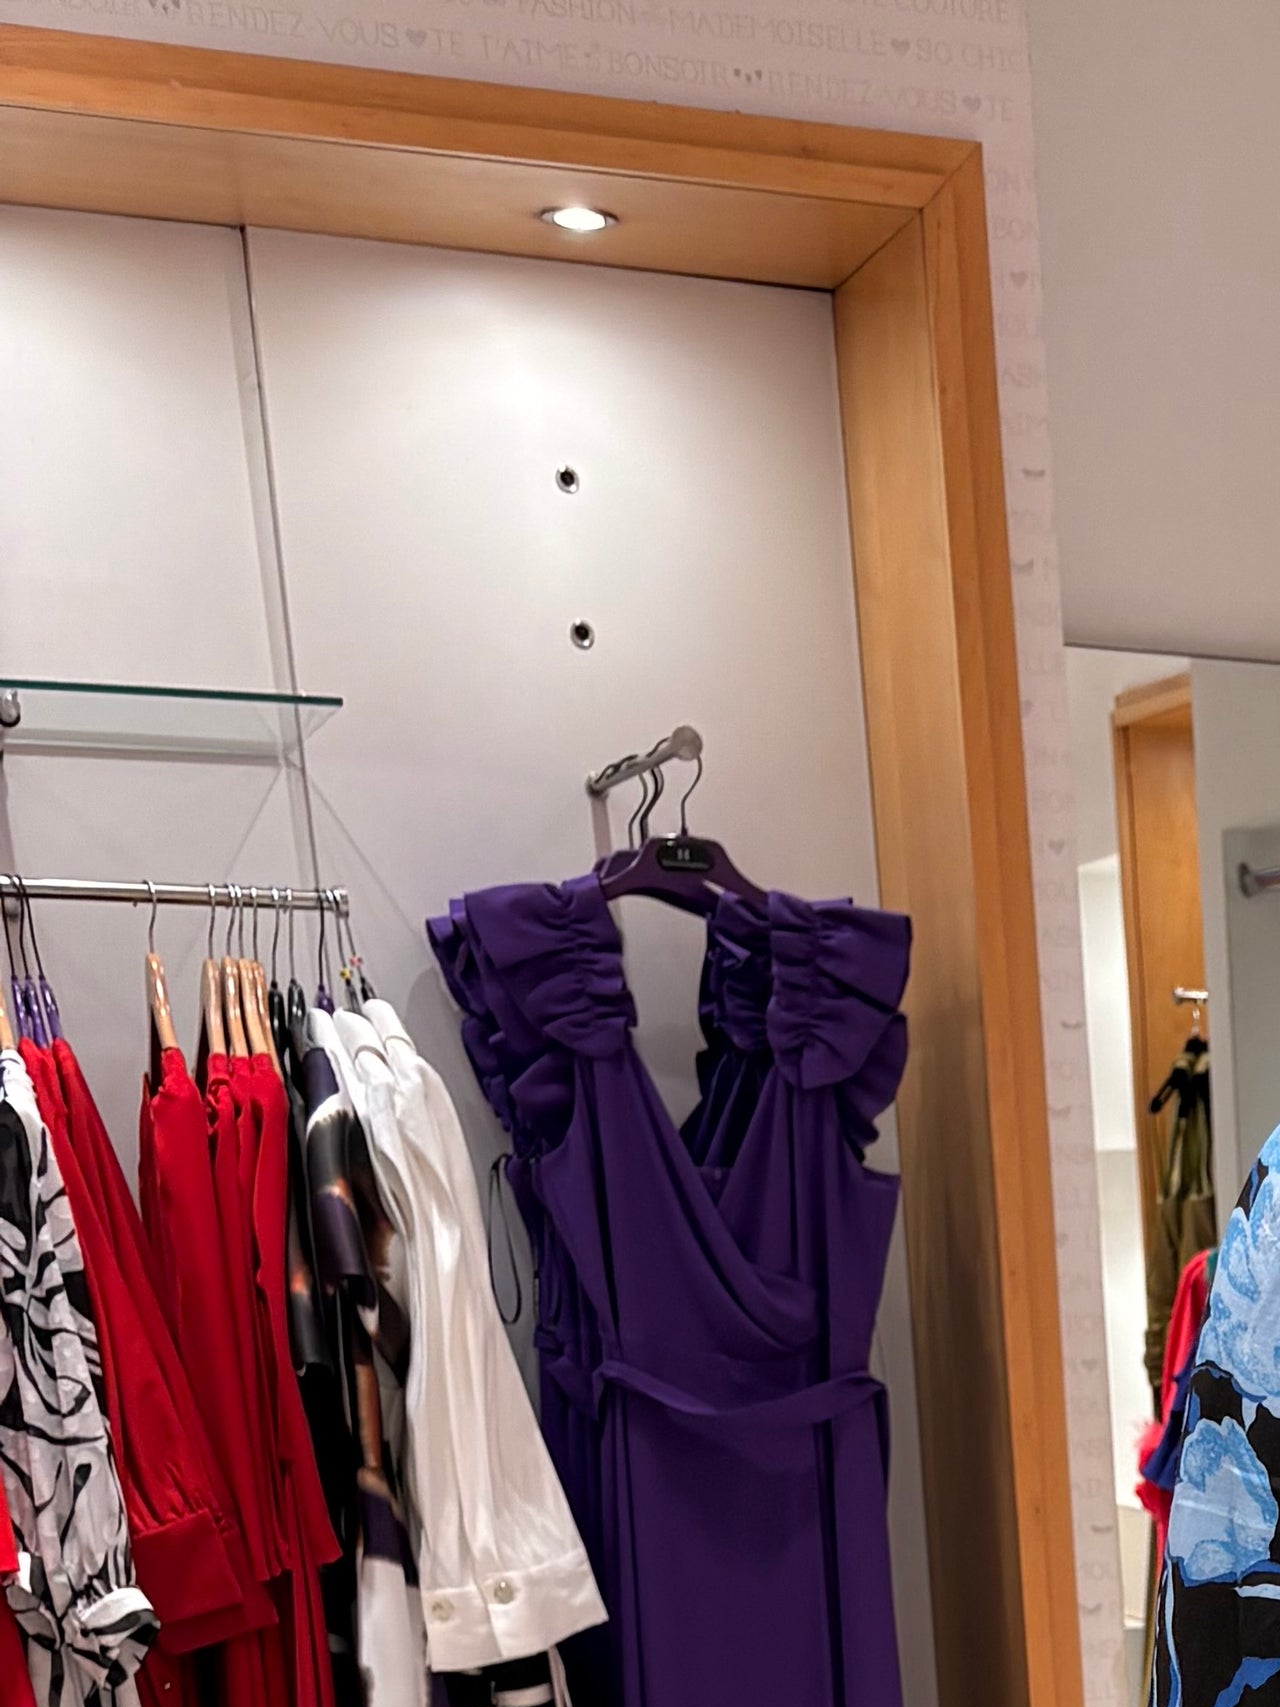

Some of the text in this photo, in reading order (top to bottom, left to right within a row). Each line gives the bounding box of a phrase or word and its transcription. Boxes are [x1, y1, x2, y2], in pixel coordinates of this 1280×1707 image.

[667, 8, 887, 56] MADEMOISELLE
[916, 36, 951, 65] SO
[961, 43, 1025, 74] CHIC
[607, 50, 731, 88] BONSOIR
